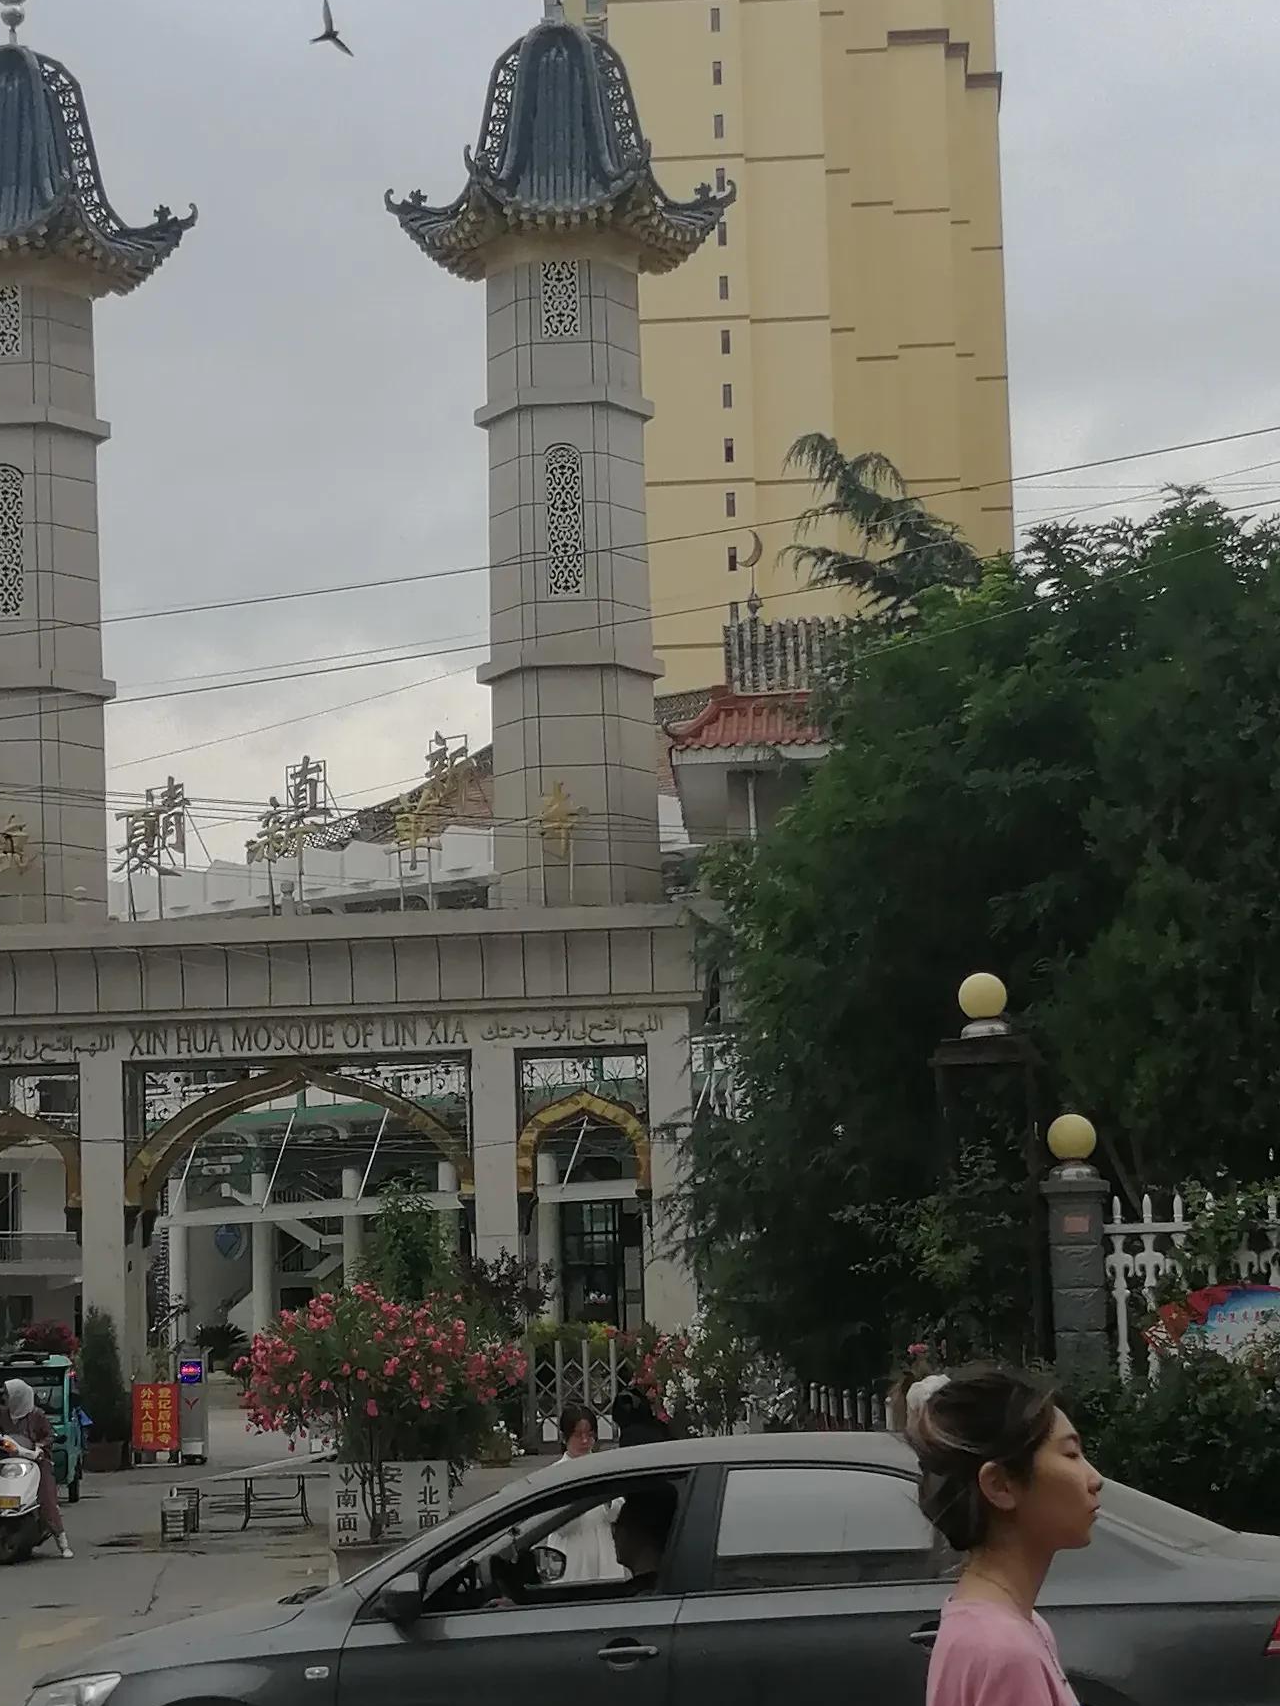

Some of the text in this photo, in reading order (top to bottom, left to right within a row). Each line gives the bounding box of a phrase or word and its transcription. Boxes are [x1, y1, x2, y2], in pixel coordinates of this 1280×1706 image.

[129, 1016, 469, 1056] XIN HUA MOSQUE OF LIN XIA
